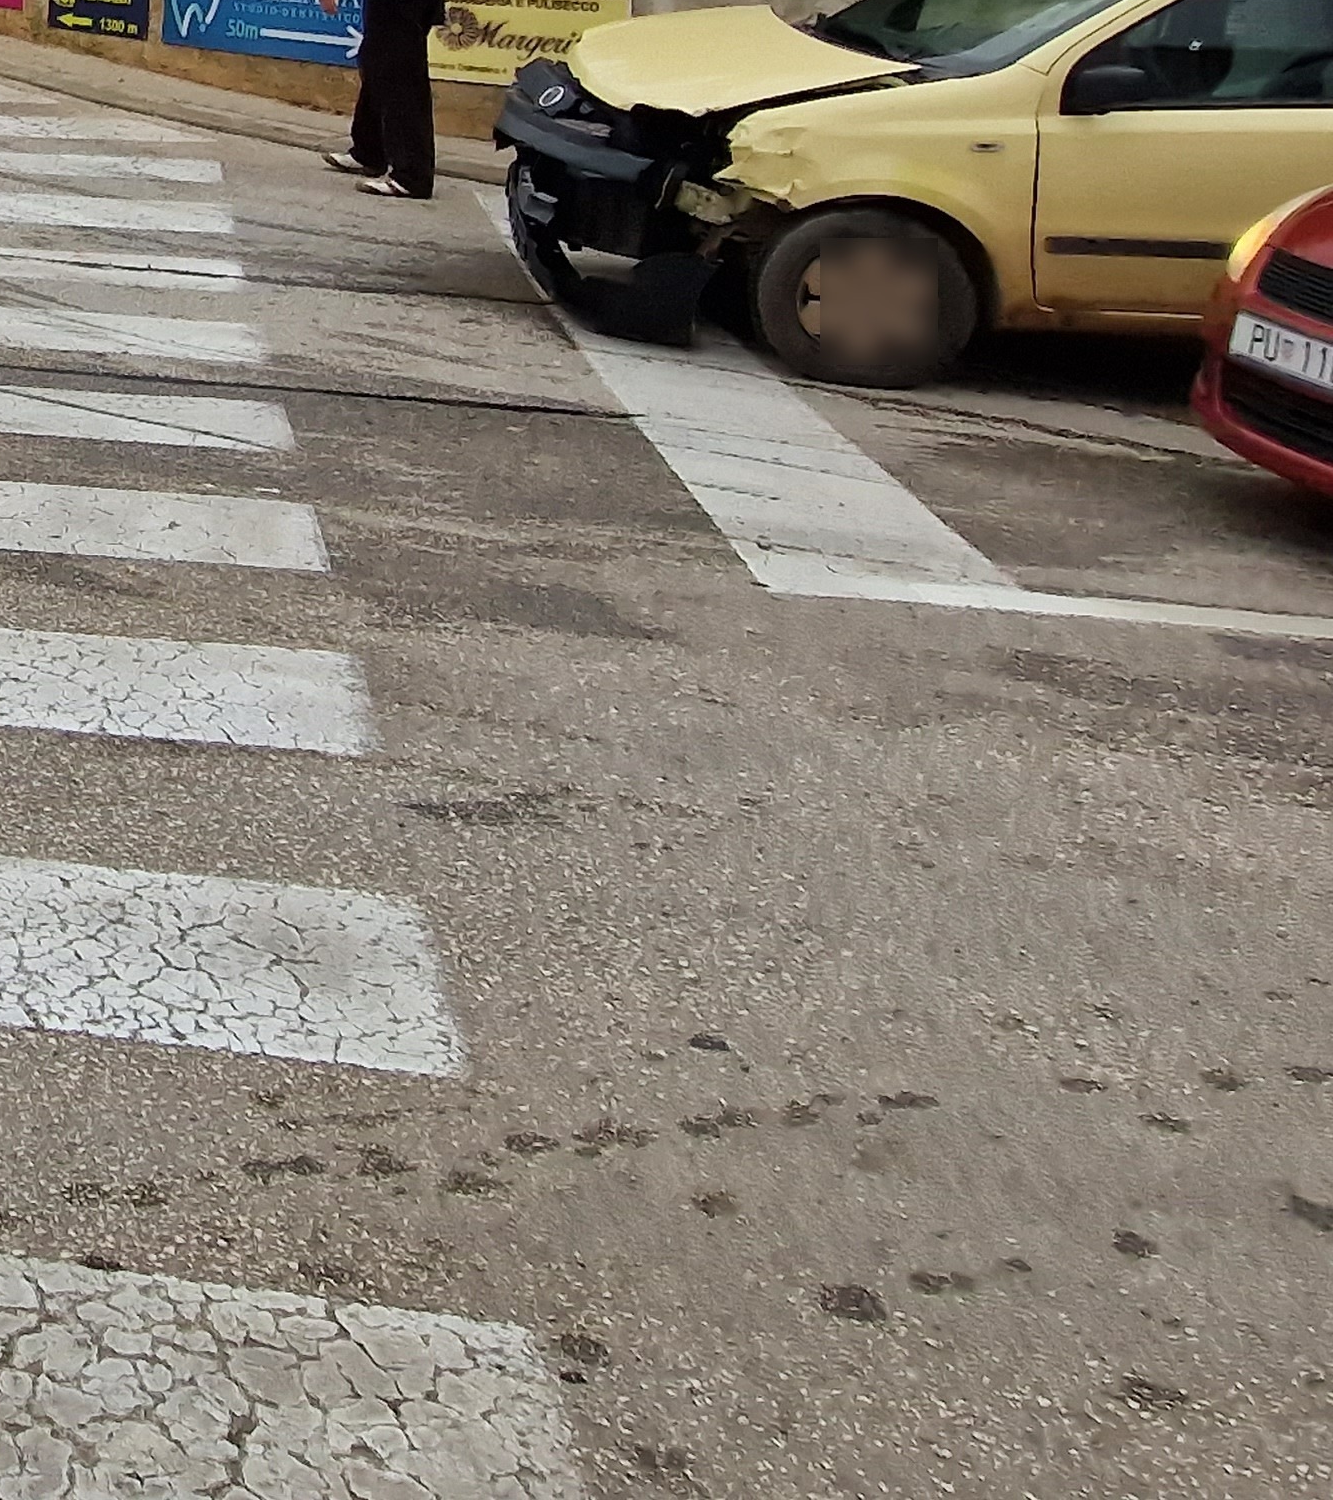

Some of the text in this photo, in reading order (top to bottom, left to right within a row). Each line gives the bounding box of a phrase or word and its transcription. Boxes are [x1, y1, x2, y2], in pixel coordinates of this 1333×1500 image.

[99, 17, 138, 35] 1300 m
[225, 18, 259, 39] 50m
[477, 20, 582, 60] Margeri
[1248, 323, 1333, 384] PU 11
